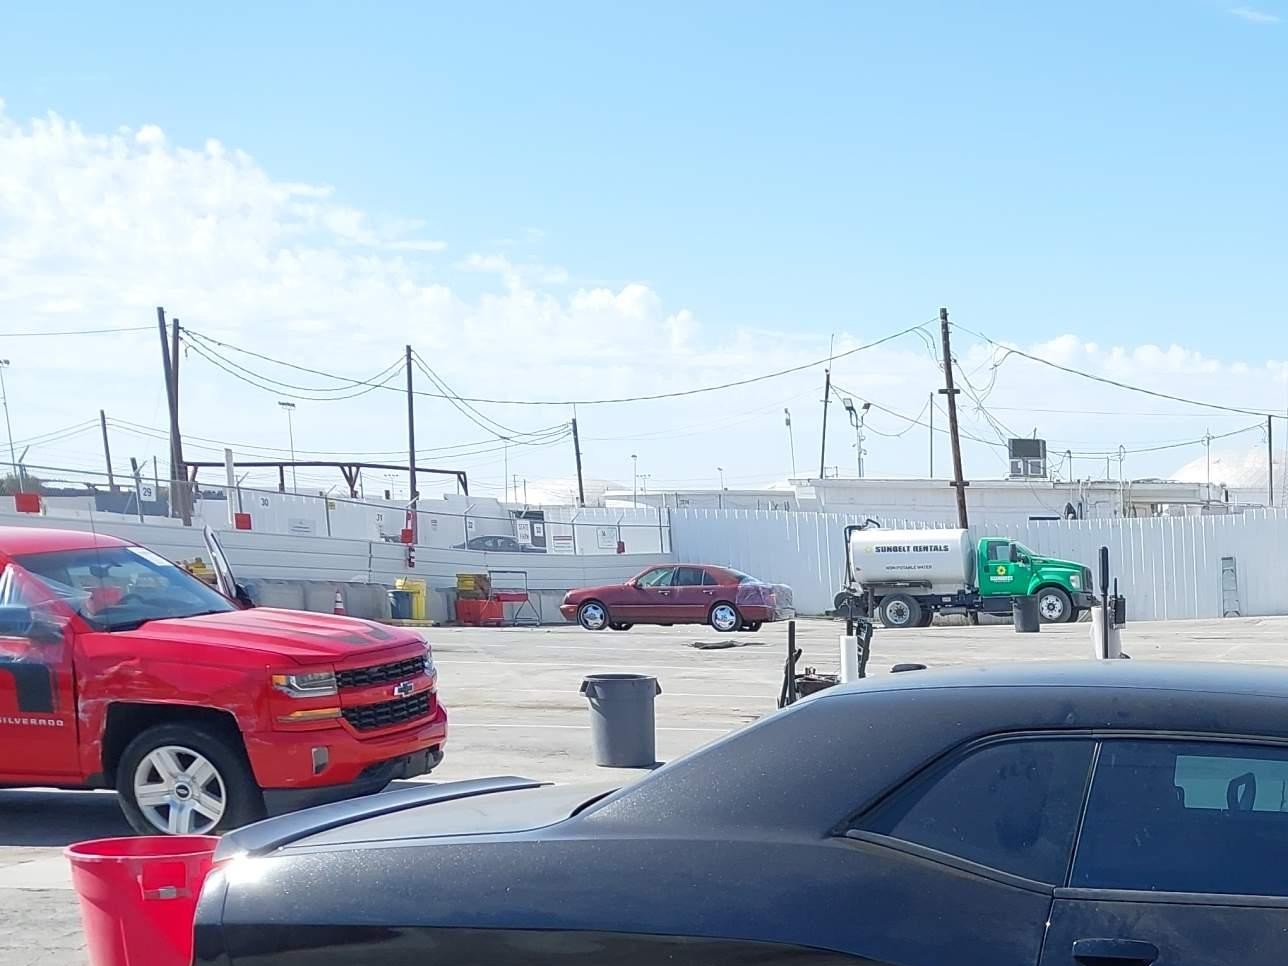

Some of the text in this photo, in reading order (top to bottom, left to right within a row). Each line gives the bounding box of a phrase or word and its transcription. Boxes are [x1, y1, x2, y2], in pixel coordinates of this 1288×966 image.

[142, 487, 152, 497] 29
[260, 497, 269, 507] 30
[875, 544, 949, 553] SUNBELT RENTALS
